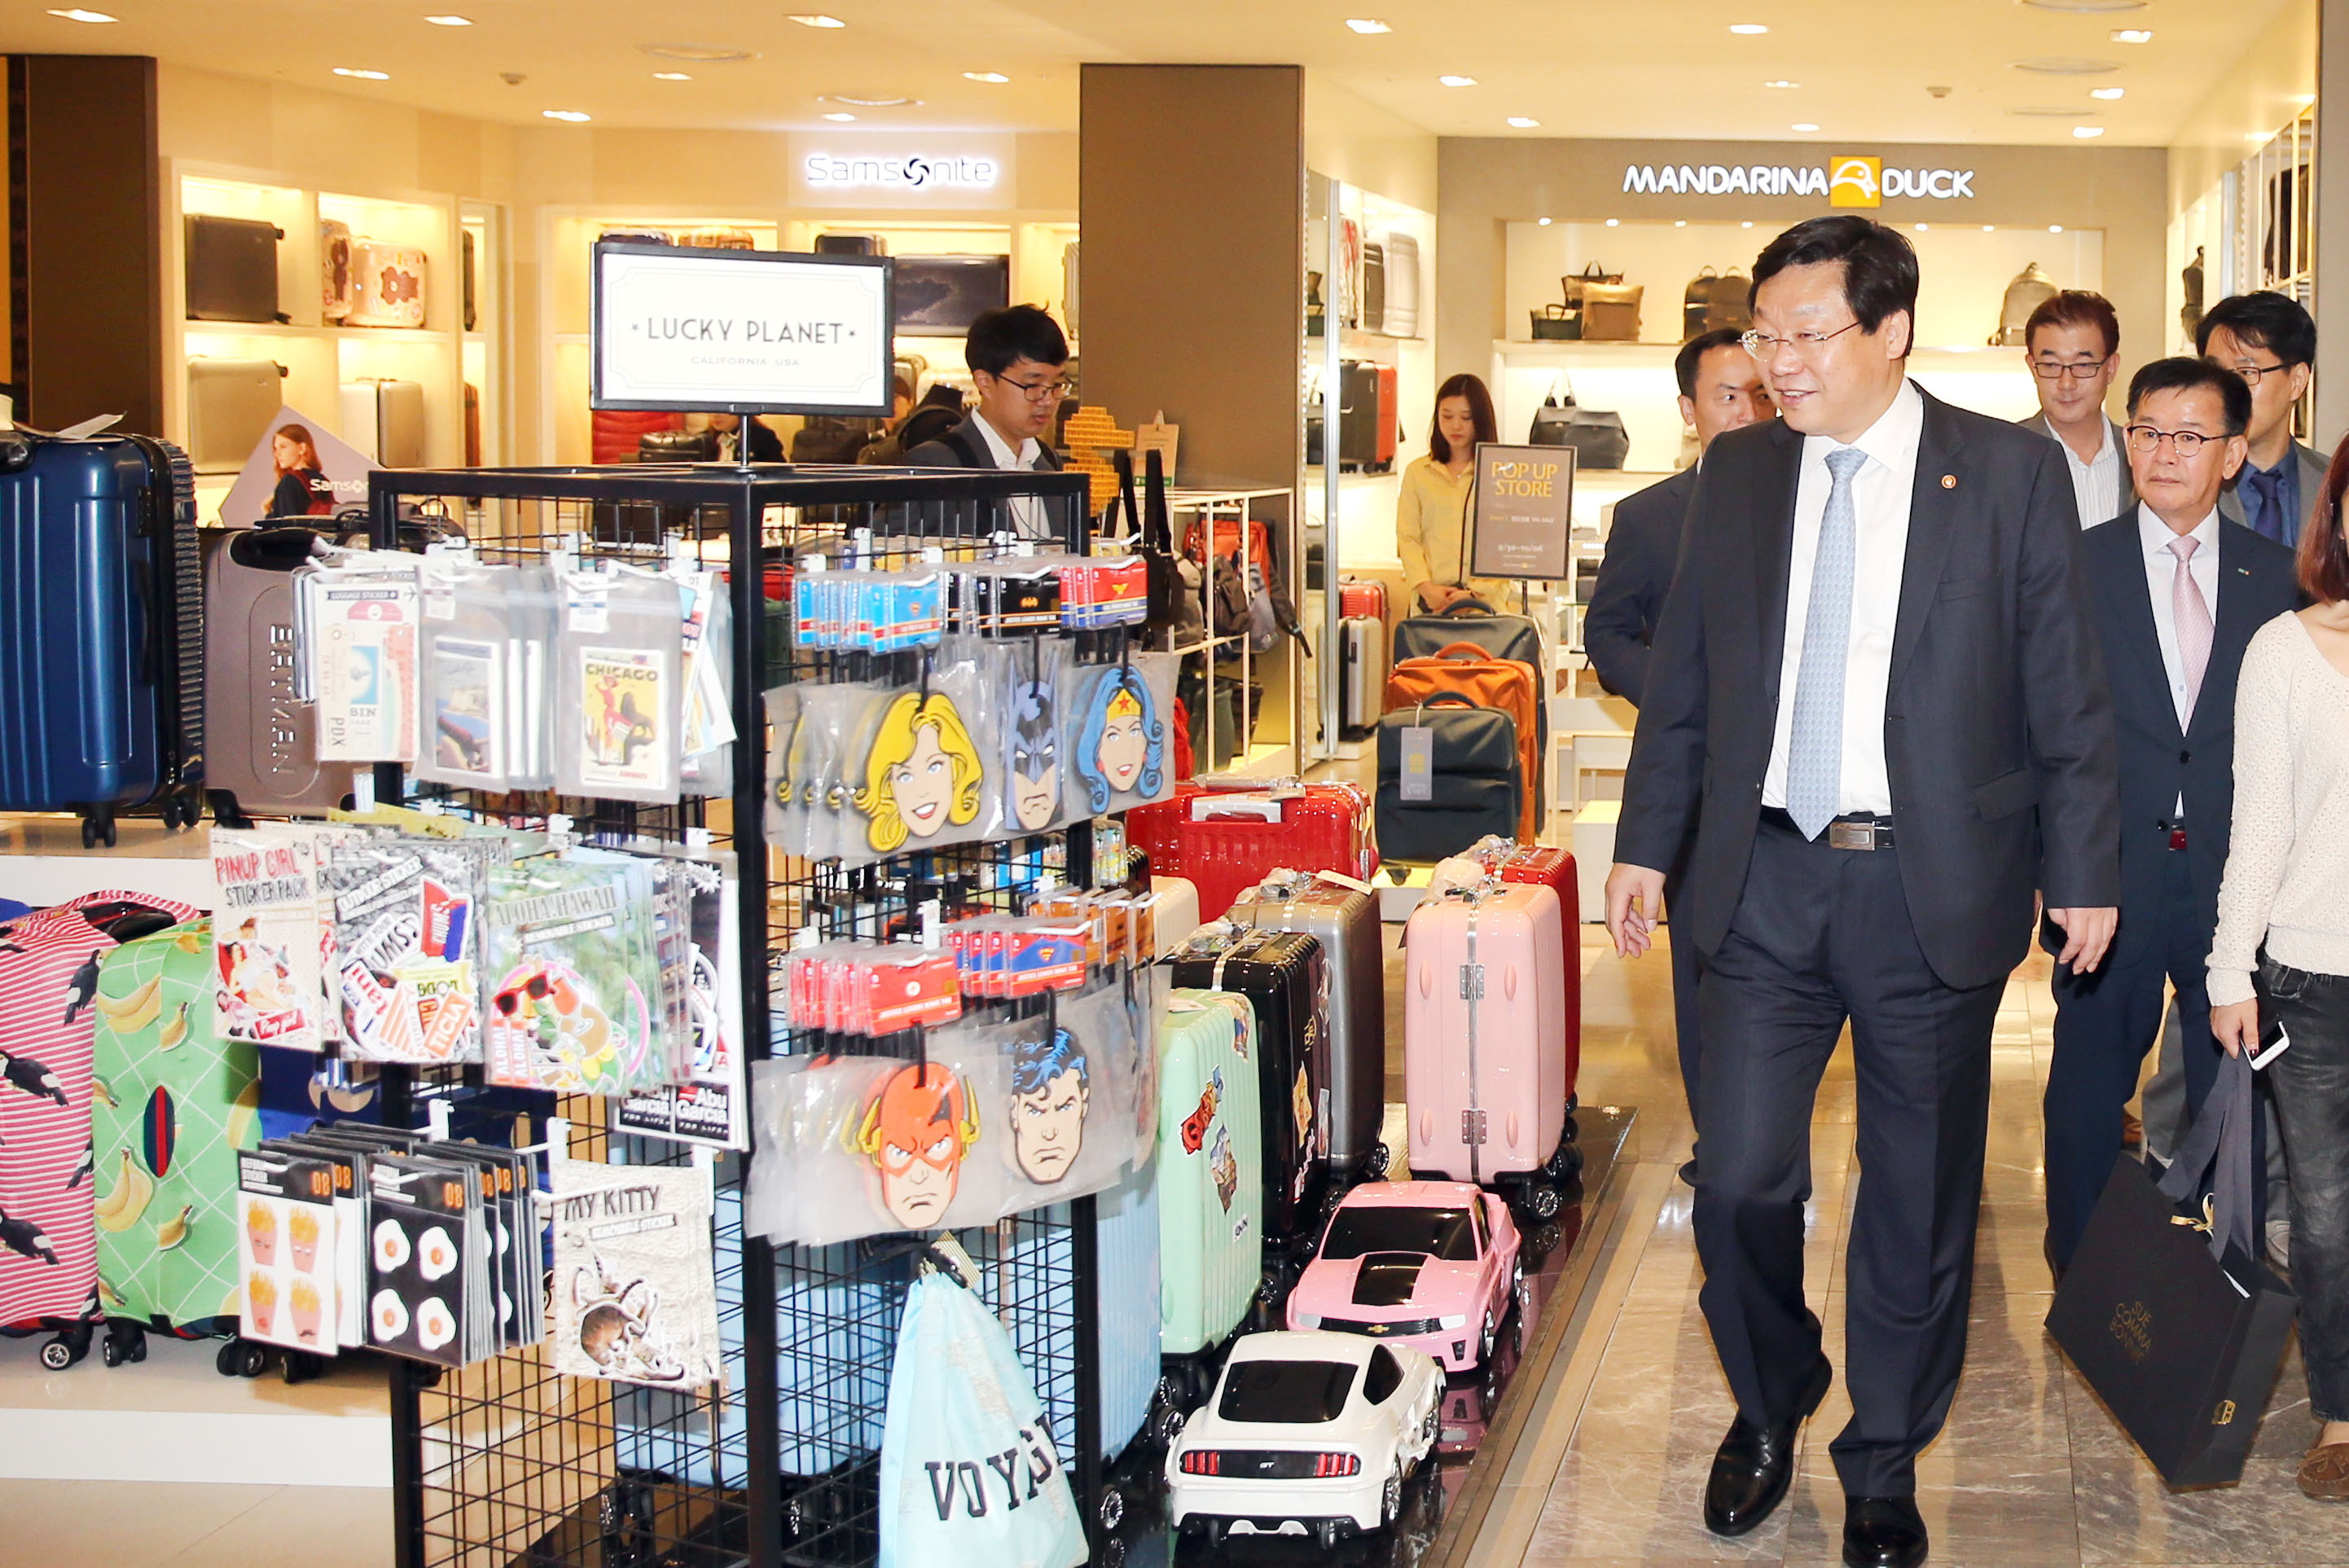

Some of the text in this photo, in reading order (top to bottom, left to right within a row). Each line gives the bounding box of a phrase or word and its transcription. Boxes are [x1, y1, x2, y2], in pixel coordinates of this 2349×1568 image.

[806, 156, 993, 187] Samsonite
[1622, 165, 1974, 199] MANDARINA DUCK
[648, 317, 843, 344] LUCKY PLANET
[691, 357, 800, 367] CALIFORNIA USA
[1491, 461, 1559, 481] POP UP
[1494, 479, 1553, 498] STORE
[586, 663, 658, 682] CHICAGO
[215, 852, 260, 884] PINUP
[266, 848, 301, 877] GIRL
[226, 876, 310, 907] STICKER PACK
[695, 1087, 727, 1109] Abu
[676, 1099, 728, 1124] Garcia
[564, 1184, 661, 1222] MY KITTY
